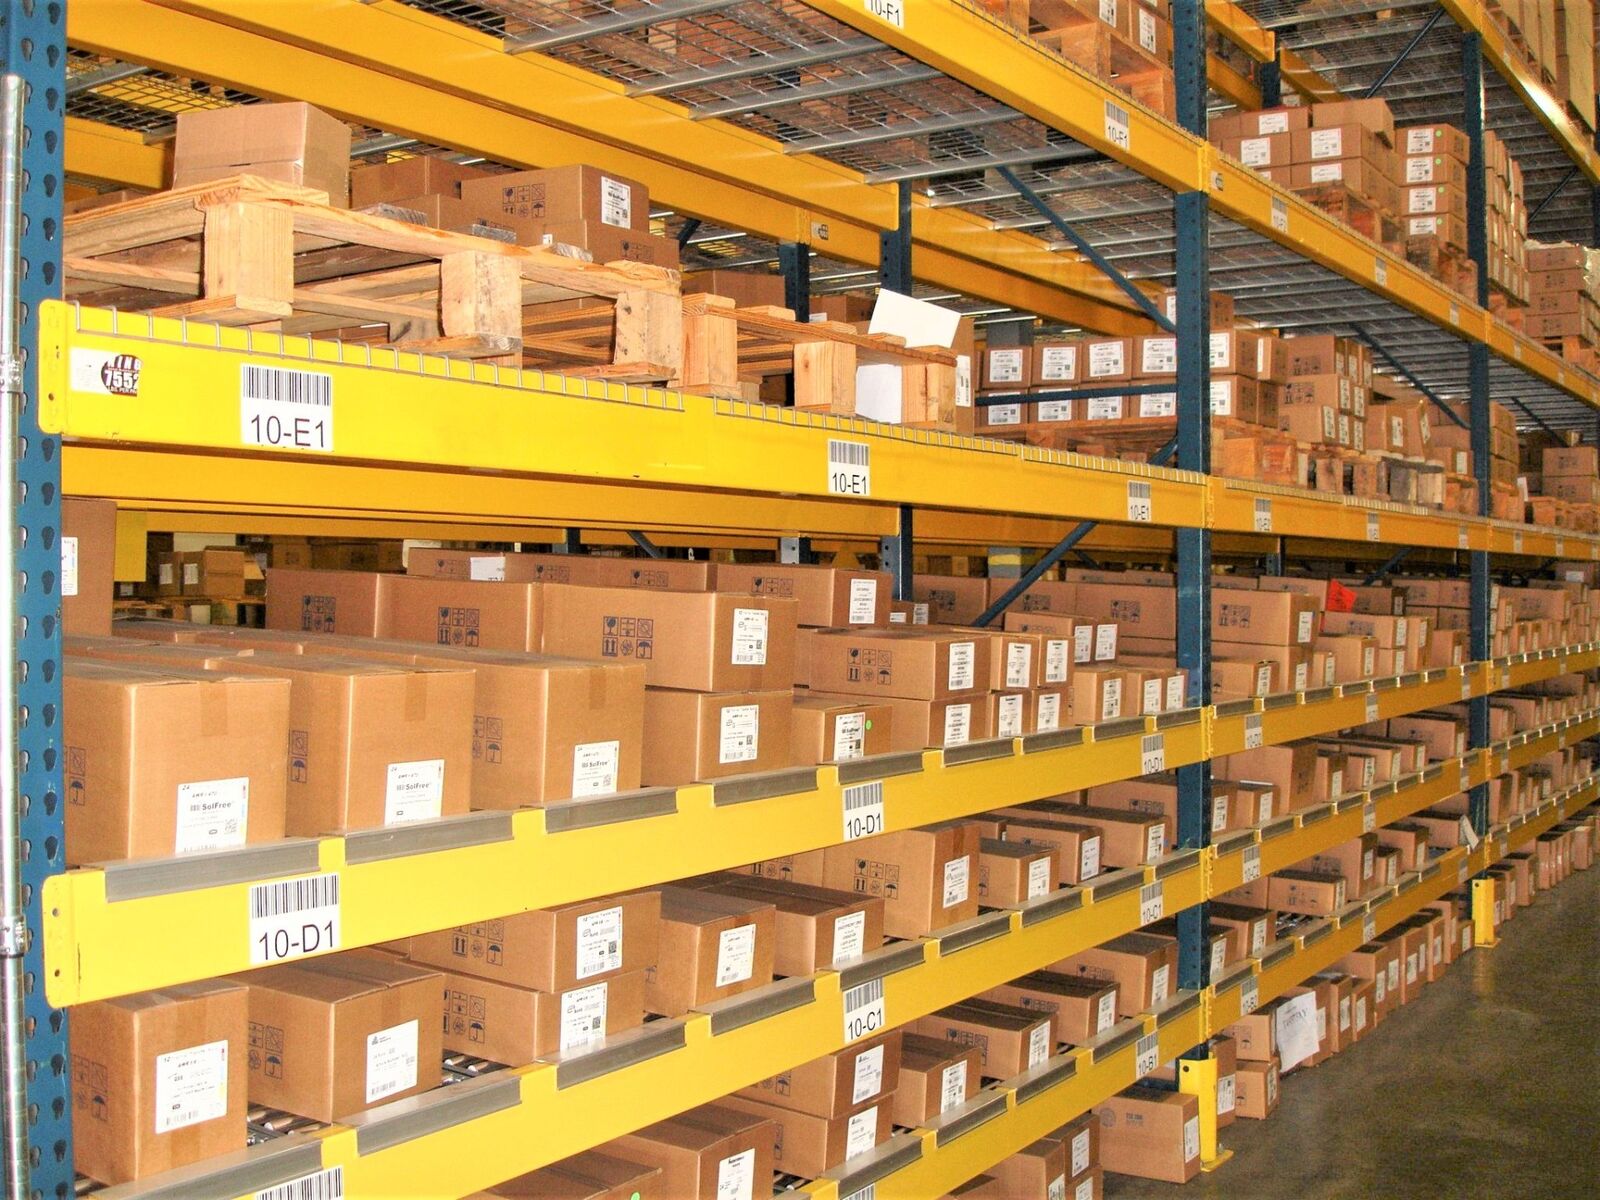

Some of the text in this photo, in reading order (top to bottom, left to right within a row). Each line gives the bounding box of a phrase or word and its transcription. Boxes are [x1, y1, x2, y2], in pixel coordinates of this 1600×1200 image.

[869, 0, 900, 26] 10-F1
[1108, 125, 1128, 149] 10-F1
[250, 414, 325, 448] 10-E1
[832, 472, 867, 495] 10-E1
[1130, 504, 1149, 520] 10-E1
[1144, 757, 1163, 774] 10-D1
[202, 802, 232, 811] SolFree
[847, 812, 882, 839] 10-D1
[1142, 904, 1161, 925] 10-C1
[259, 920, 335, 960] 10-D1
[848, 1007, 883, 1040] 10-C1
[1139, 1053, 1157, 1076] 10-B1
